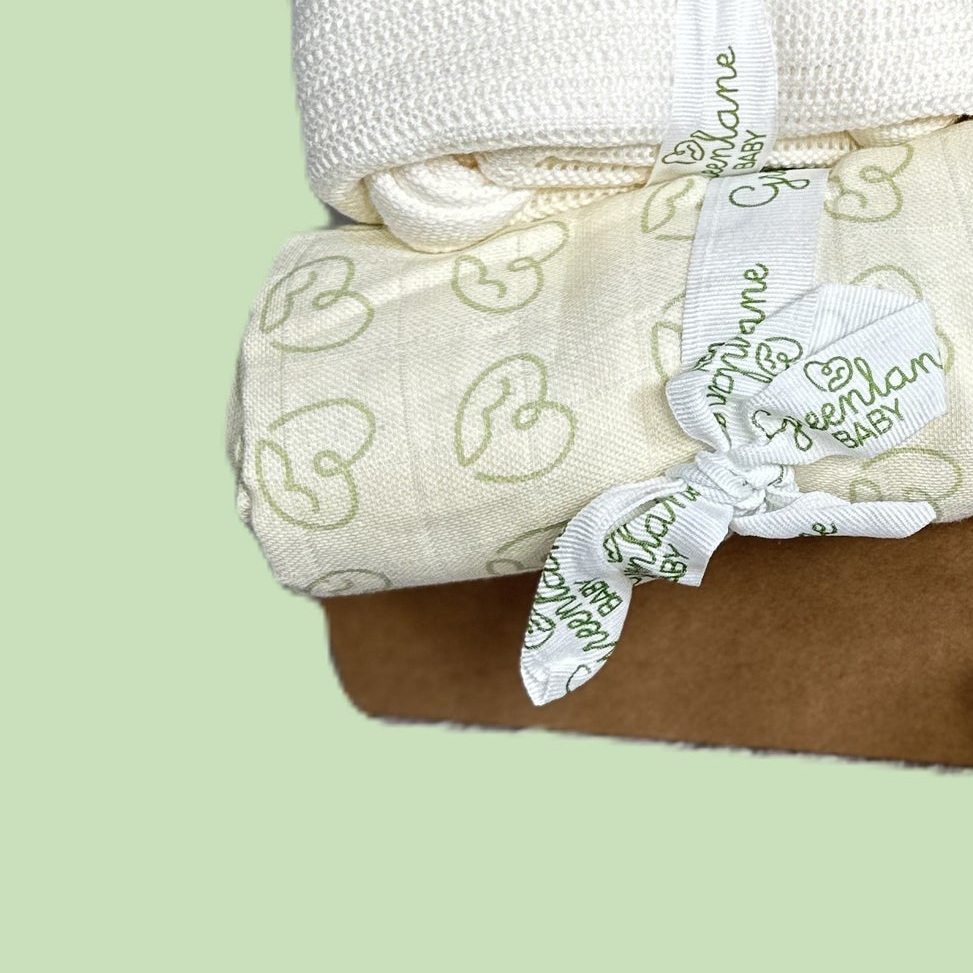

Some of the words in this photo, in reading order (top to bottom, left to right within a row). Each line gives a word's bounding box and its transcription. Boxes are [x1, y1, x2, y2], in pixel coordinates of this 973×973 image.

[732, 130, 767, 170] BABY
[832, 398, 904, 448] BABY
[574, 578, 623, 617] BABY
